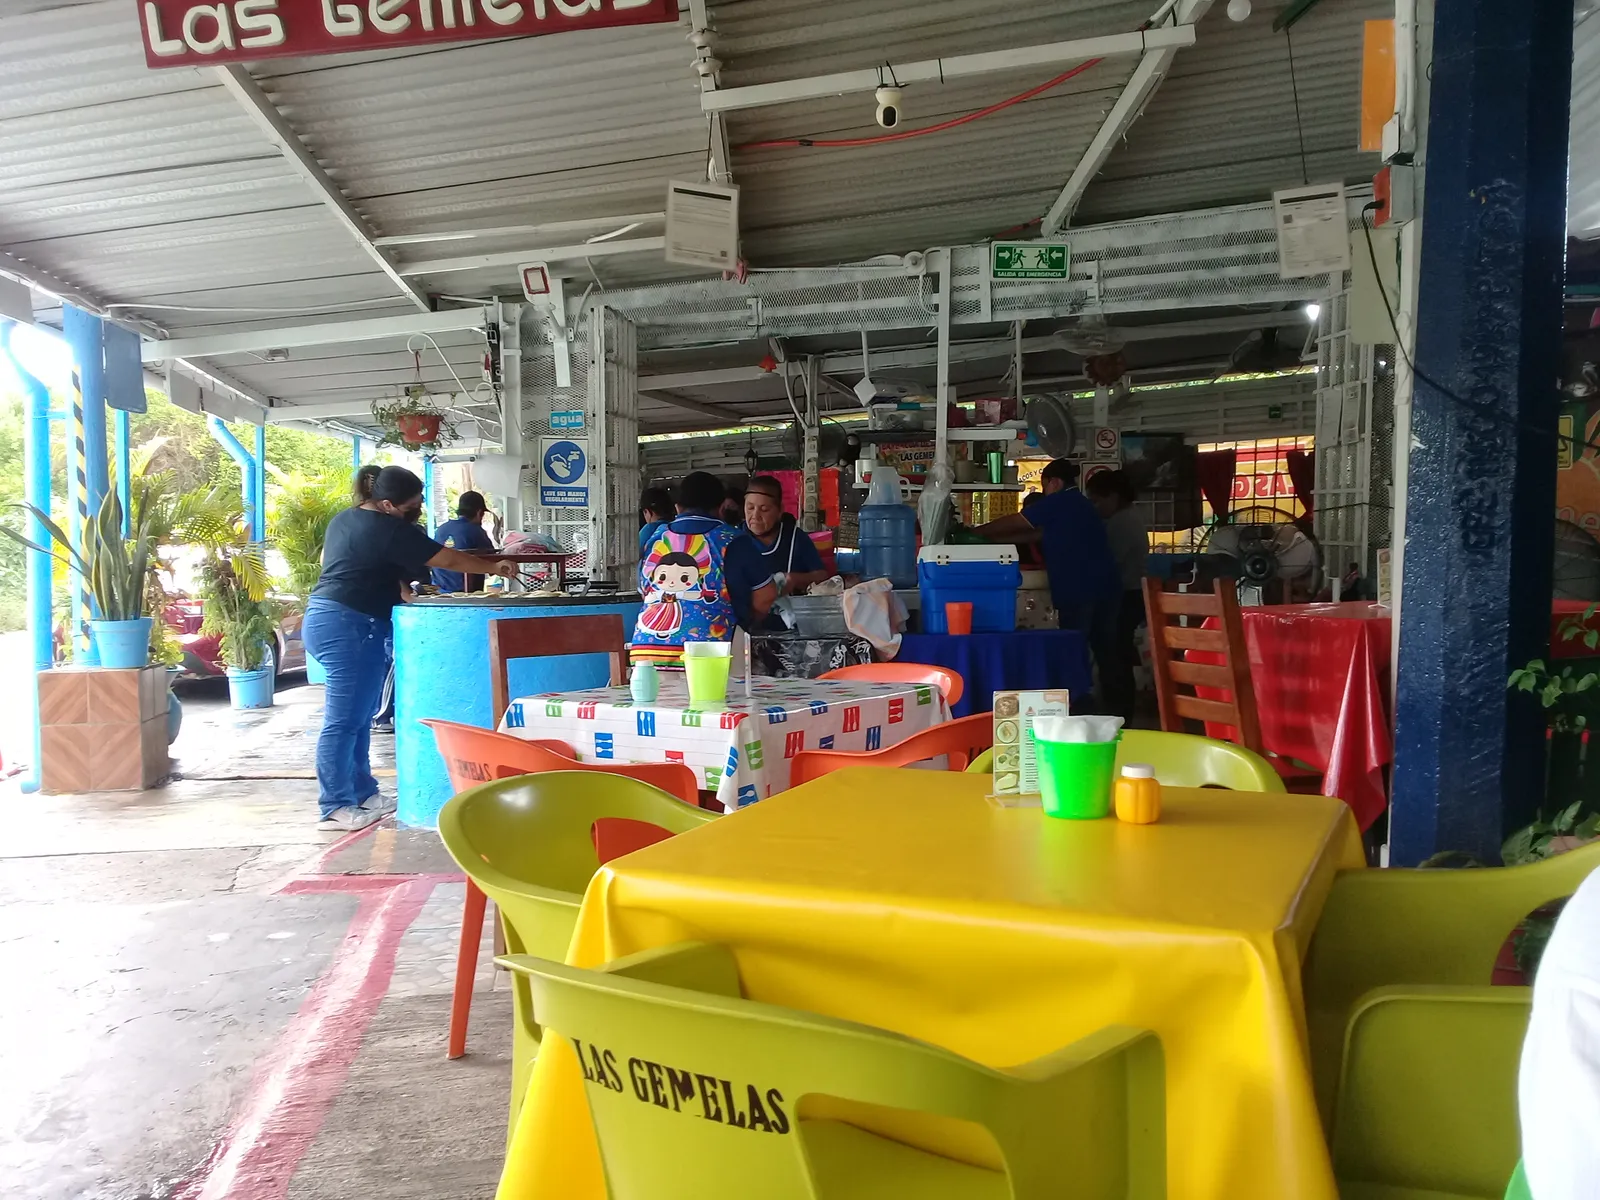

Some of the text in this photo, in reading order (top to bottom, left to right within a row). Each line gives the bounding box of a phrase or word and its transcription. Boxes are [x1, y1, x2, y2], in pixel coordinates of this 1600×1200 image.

[144, 0, 286, 56] Las
[552, 414, 583, 426] agua
[570, 1036, 790, 1135] LAS GEMELAS
